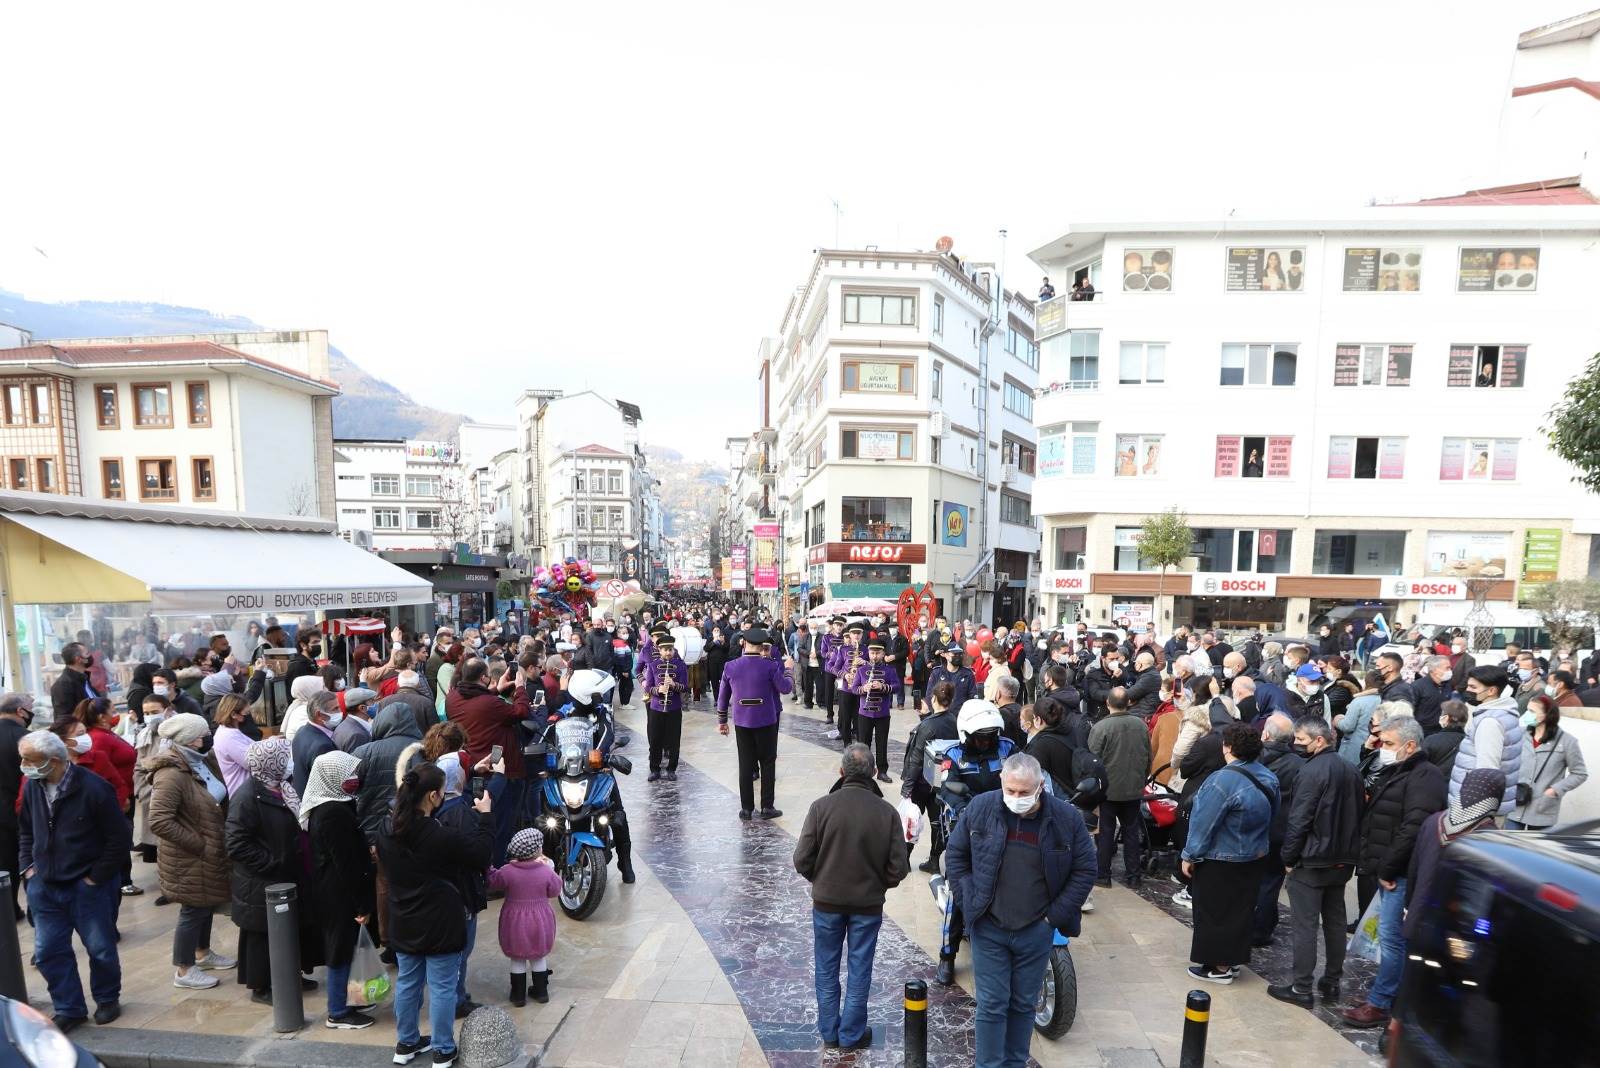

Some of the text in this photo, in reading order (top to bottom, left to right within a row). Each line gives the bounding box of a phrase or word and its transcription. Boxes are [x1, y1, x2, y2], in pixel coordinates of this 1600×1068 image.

[850, 546, 903, 560] nesos
[1056, 578, 1082, 588] BOSCH
[1222, 580, 1266, 591] BOSCH
[1411, 584, 1456, 594] BOSCH
[226, 595, 264, 609] ORDU
